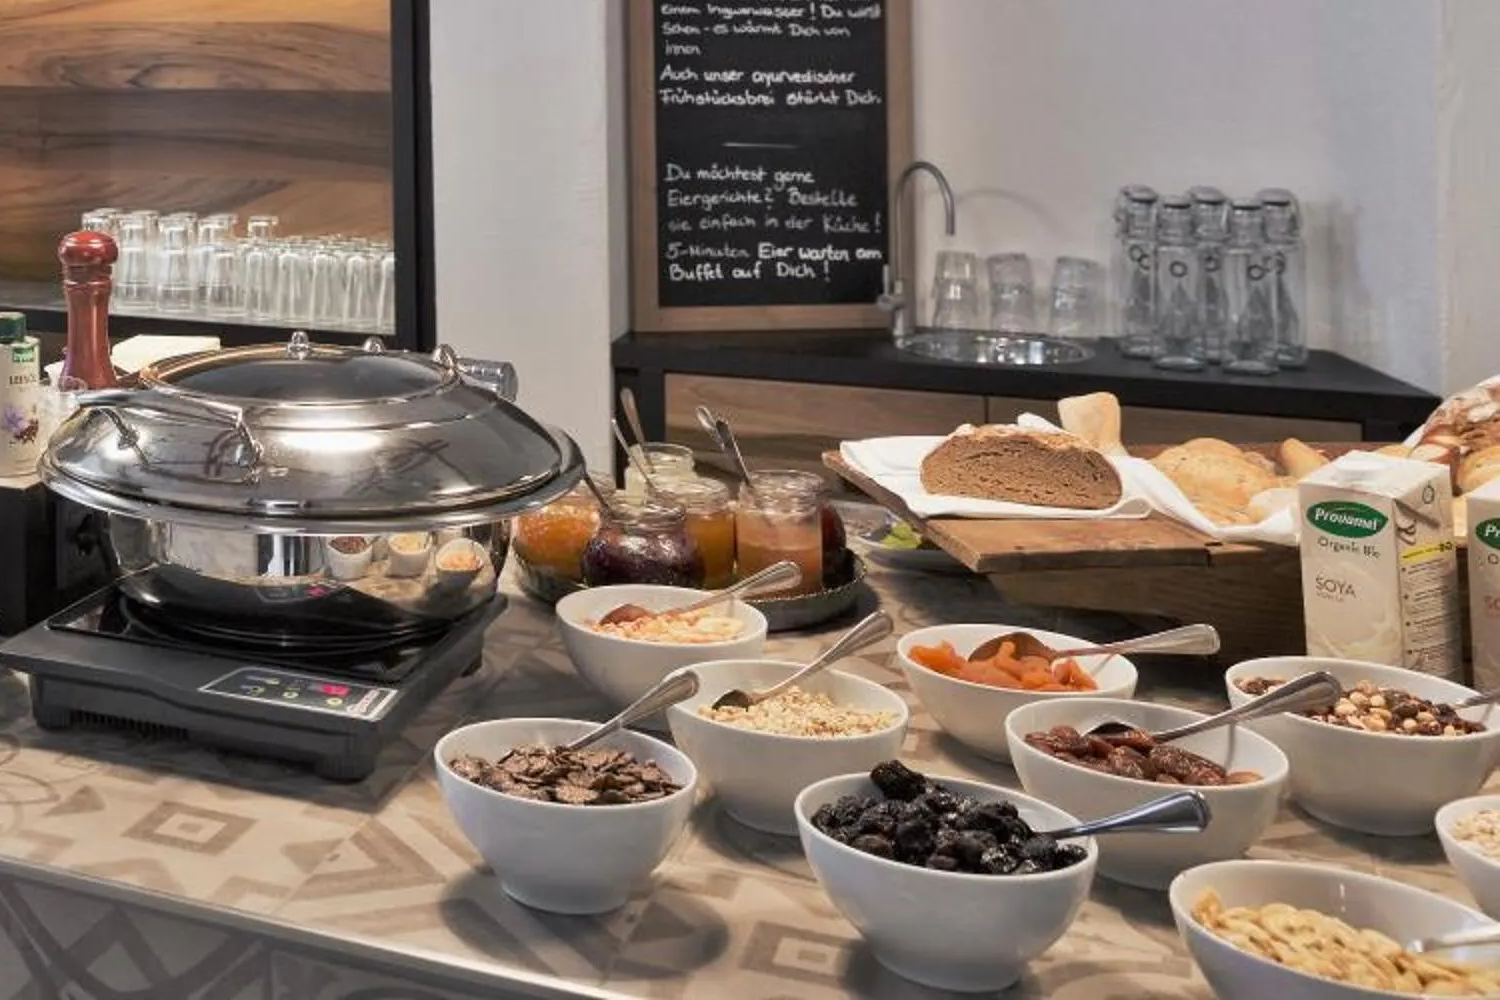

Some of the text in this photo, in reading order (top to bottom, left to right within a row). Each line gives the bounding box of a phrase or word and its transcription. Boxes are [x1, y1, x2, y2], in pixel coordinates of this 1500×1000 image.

[820, 4, 843, 18] Du
[660, 64, 856, 87] Auch unser ayurvedischer
[786, 88, 840, 106] stärkt
[663, 162, 815, 191] Du möchtest gerne
[787, 186, 858, 207] Bestelle
[699, 213, 756, 231] einfach
[764, 216, 779, 228] in
[785, 216, 814, 230] der
[758, 242, 794, 259] Eier
[798, 244, 850, 262] warten
[855, 248, 883, 260] am
[669, 262, 724, 281] Buffet
[732, 261, 762, 279] auf
[1315, 508, 1378, 530] Provamel
[1315, 577, 1357, 596] SOYA
